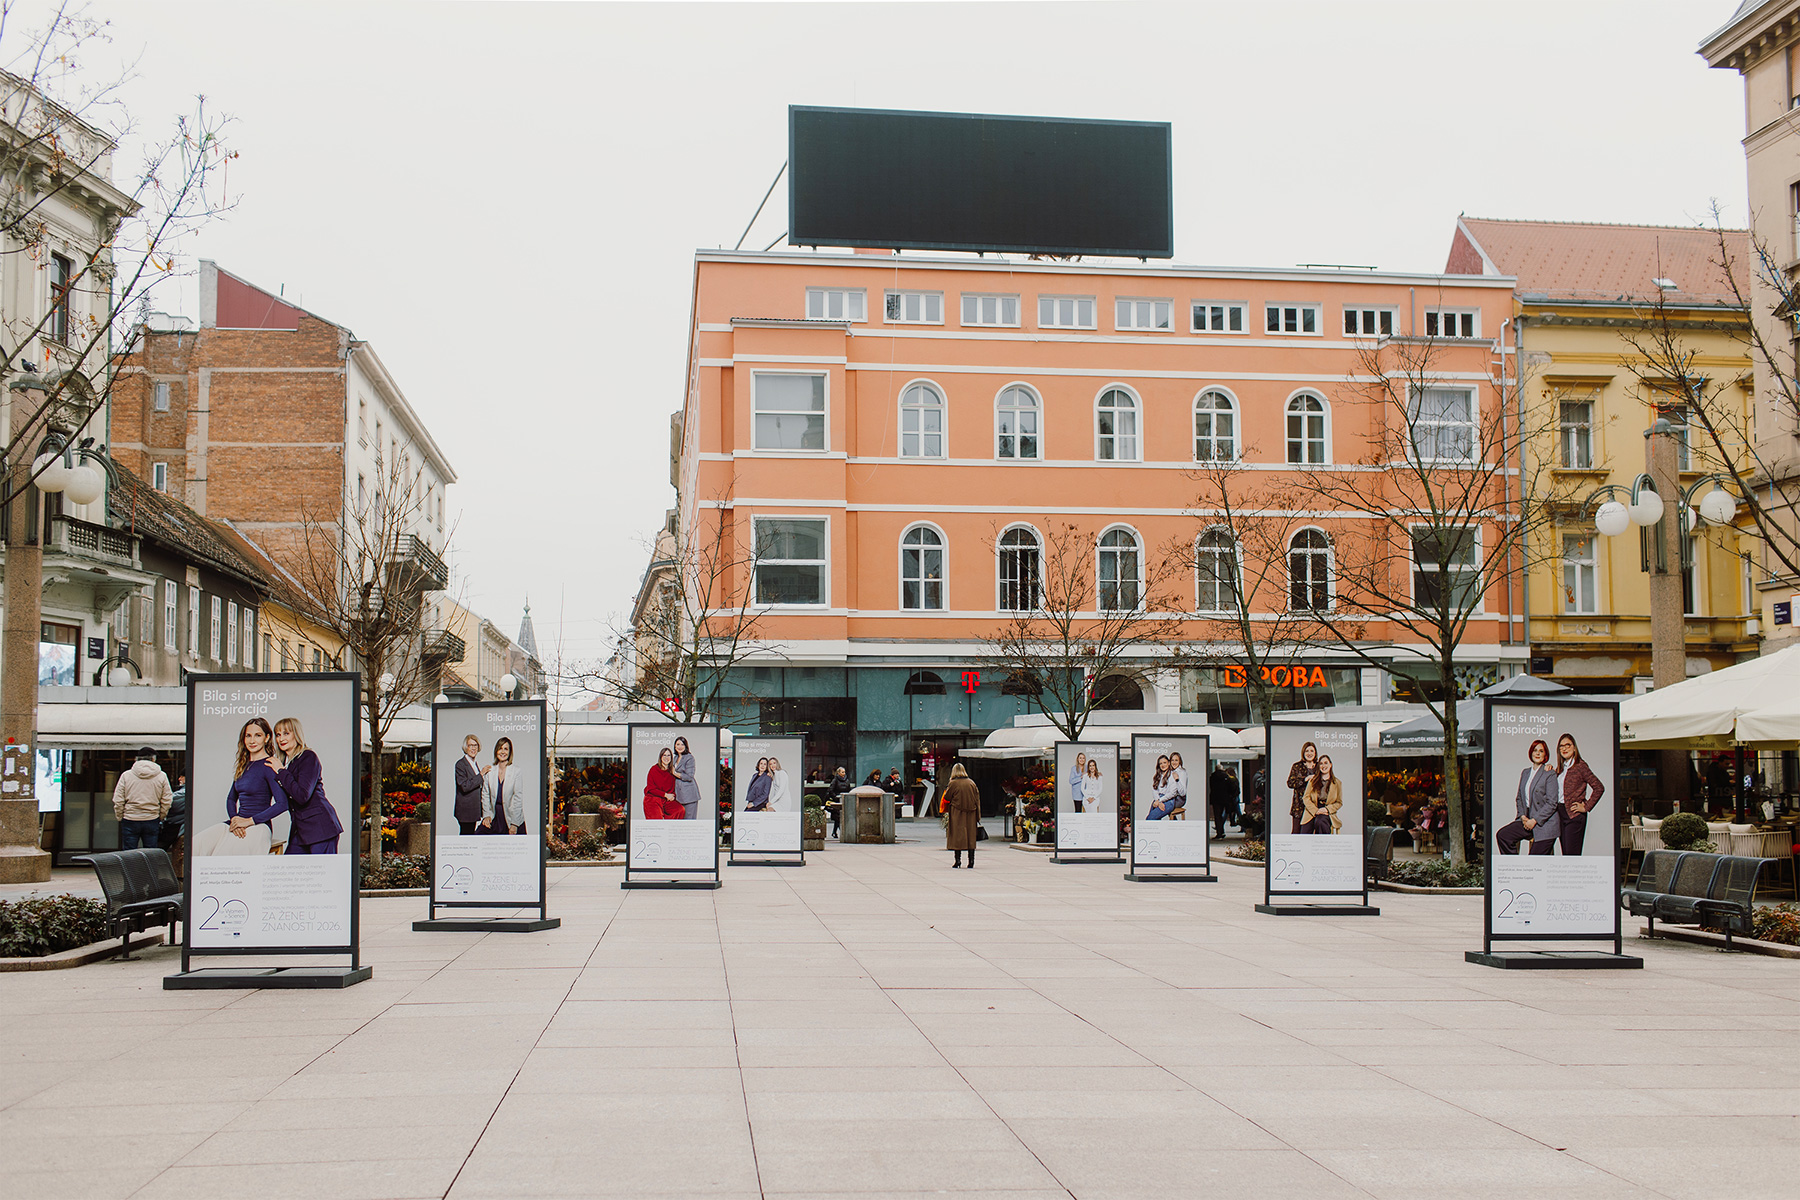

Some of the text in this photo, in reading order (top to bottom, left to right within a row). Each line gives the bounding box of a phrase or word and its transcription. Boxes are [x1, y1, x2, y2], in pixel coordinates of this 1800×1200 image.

[203, 689, 277, 703] Bila si moja
[203, 703, 268, 717] inspiracija
[487, 712, 537, 724] Bila si moja
[1496, 712, 1555, 726] Bila si moja
[493, 722, 537, 733] inspiracija
[1497, 724, 1548, 737] inspiracija
[658, 730, 676, 739] moja
[1314, 731, 1358, 741] Bila si moja
[636, 738, 671, 746] inspiracija
[1320, 740, 1358, 750] inspiracija
[1546, 902, 1589, 912] ZA ŽENE U
[261, 910, 316, 921] ZA ŽENE U
[1546, 912, 1609, 921] ZNANOSTI 2026.
[261, 921, 342, 932] ZNANOSTI 2026.
